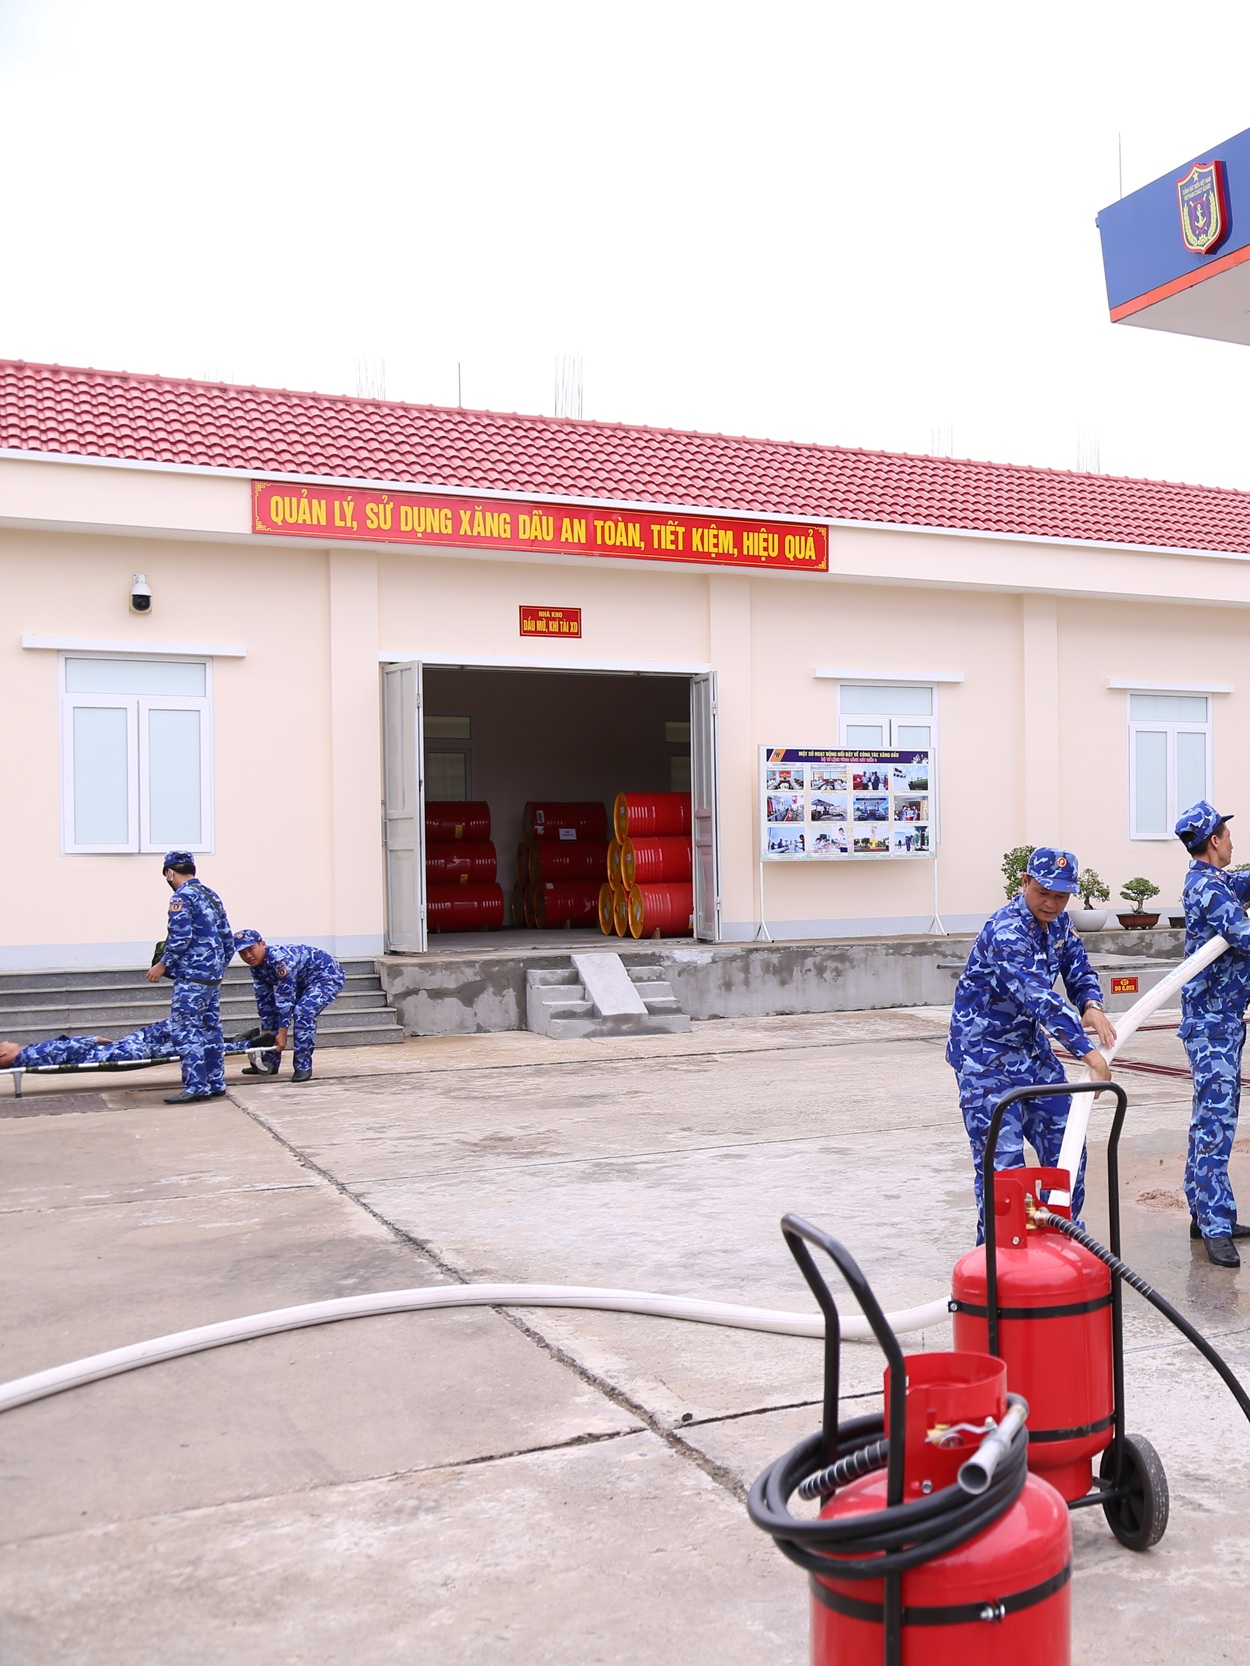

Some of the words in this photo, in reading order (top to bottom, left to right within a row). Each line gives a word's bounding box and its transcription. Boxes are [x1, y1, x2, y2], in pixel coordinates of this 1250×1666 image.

[270, 488, 327, 526] QUẢN
[334, 495, 358, 531] LÝ,
[365, 494, 394, 530] SỬ
[400, 505, 453, 537] DỤNG
[459, 505, 511, 538] XĂNG
[518, 509, 554, 541] DẦU
[560, 517, 587, 543] AN
[594, 516, 645, 550] TOÀN,
[650, 520, 686, 551] TIẾT
[691, 524, 738, 557] KIỆM,
[742, 527, 779, 561] HIỆU
[784, 528, 817, 561] QUẢ
